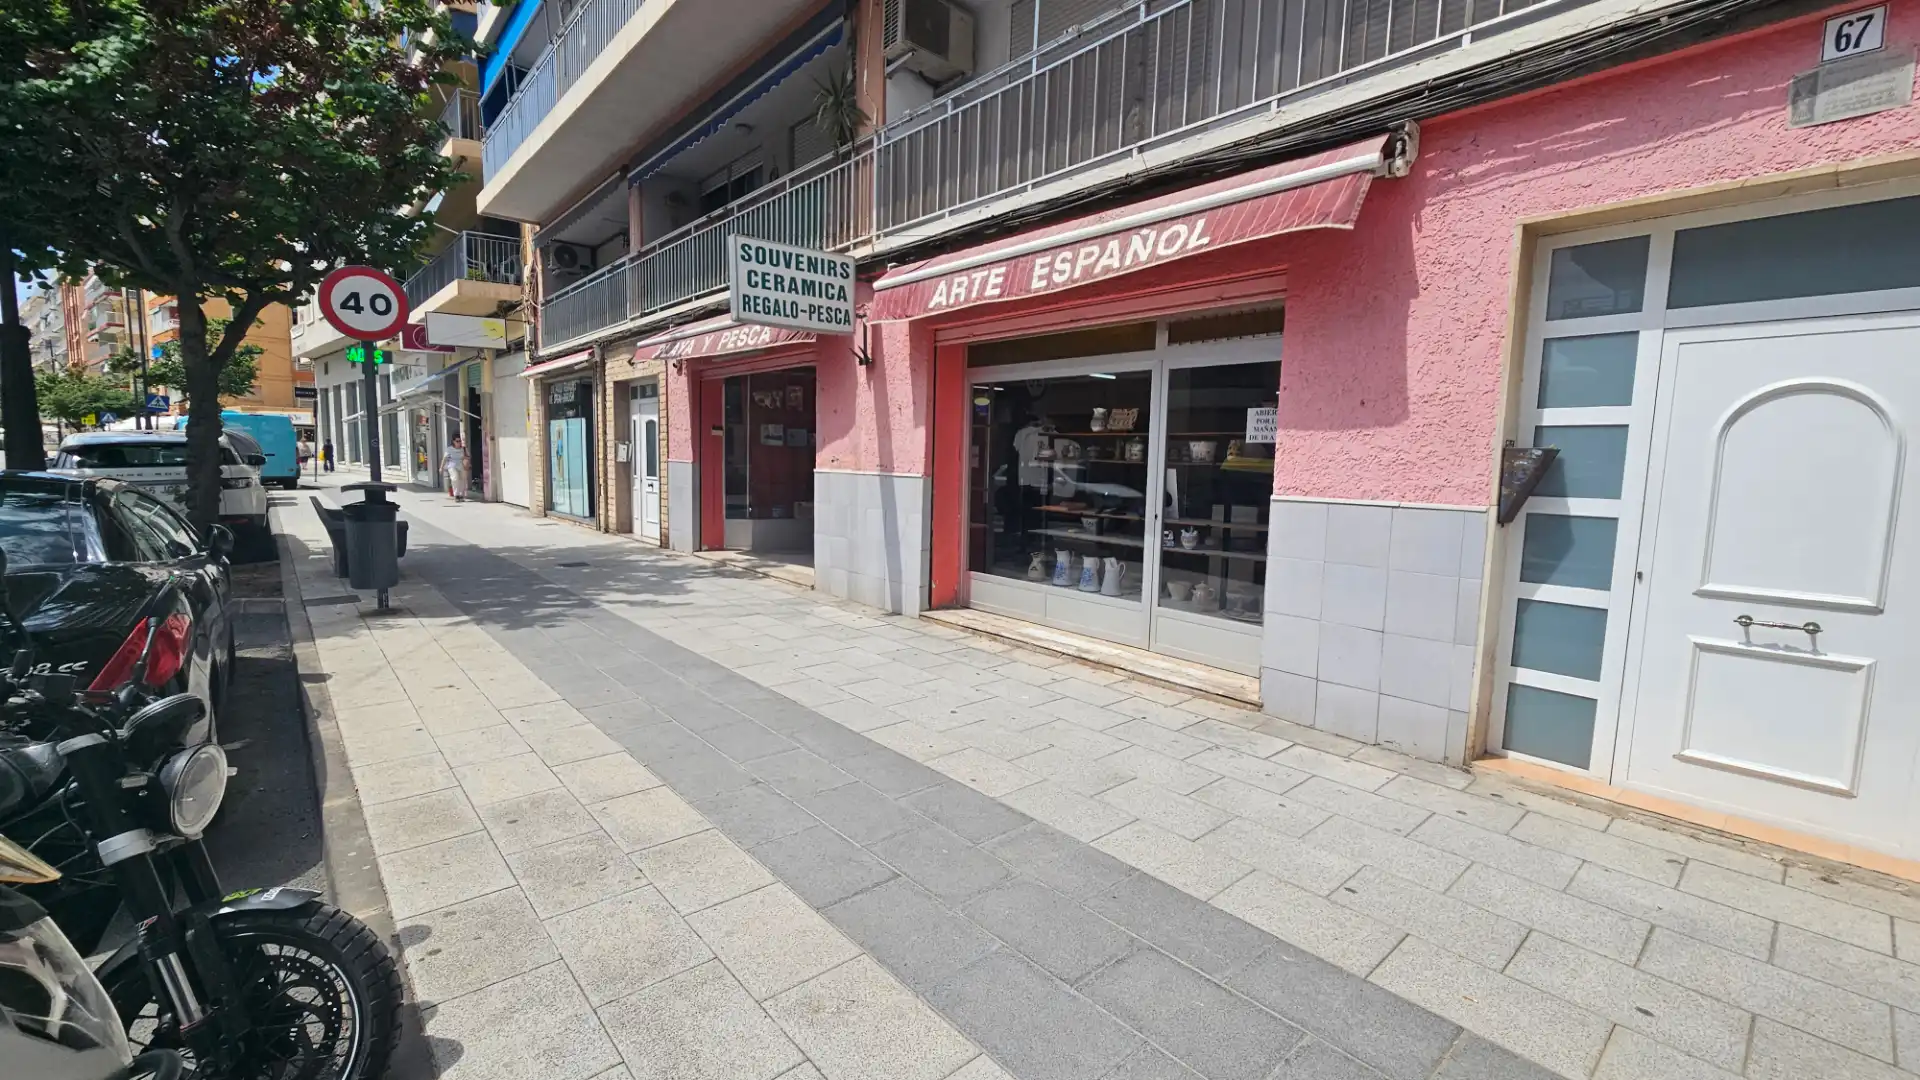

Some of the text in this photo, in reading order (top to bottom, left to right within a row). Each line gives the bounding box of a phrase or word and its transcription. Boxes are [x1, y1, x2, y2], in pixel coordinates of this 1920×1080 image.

[1834, 12, 1875, 53] 67
[739, 243, 850, 280] SOUVENIRS
[928, 218, 1211, 309] ARTE ESPAÑOL
[747, 269, 848, 302] CERAMICA
[339, 291, 392, 316] 40
[742, 293, 851, 326] REGALO-PESCA
[701, 335, 714, 353] Y
[717, 325, 771, 350] PESCA
